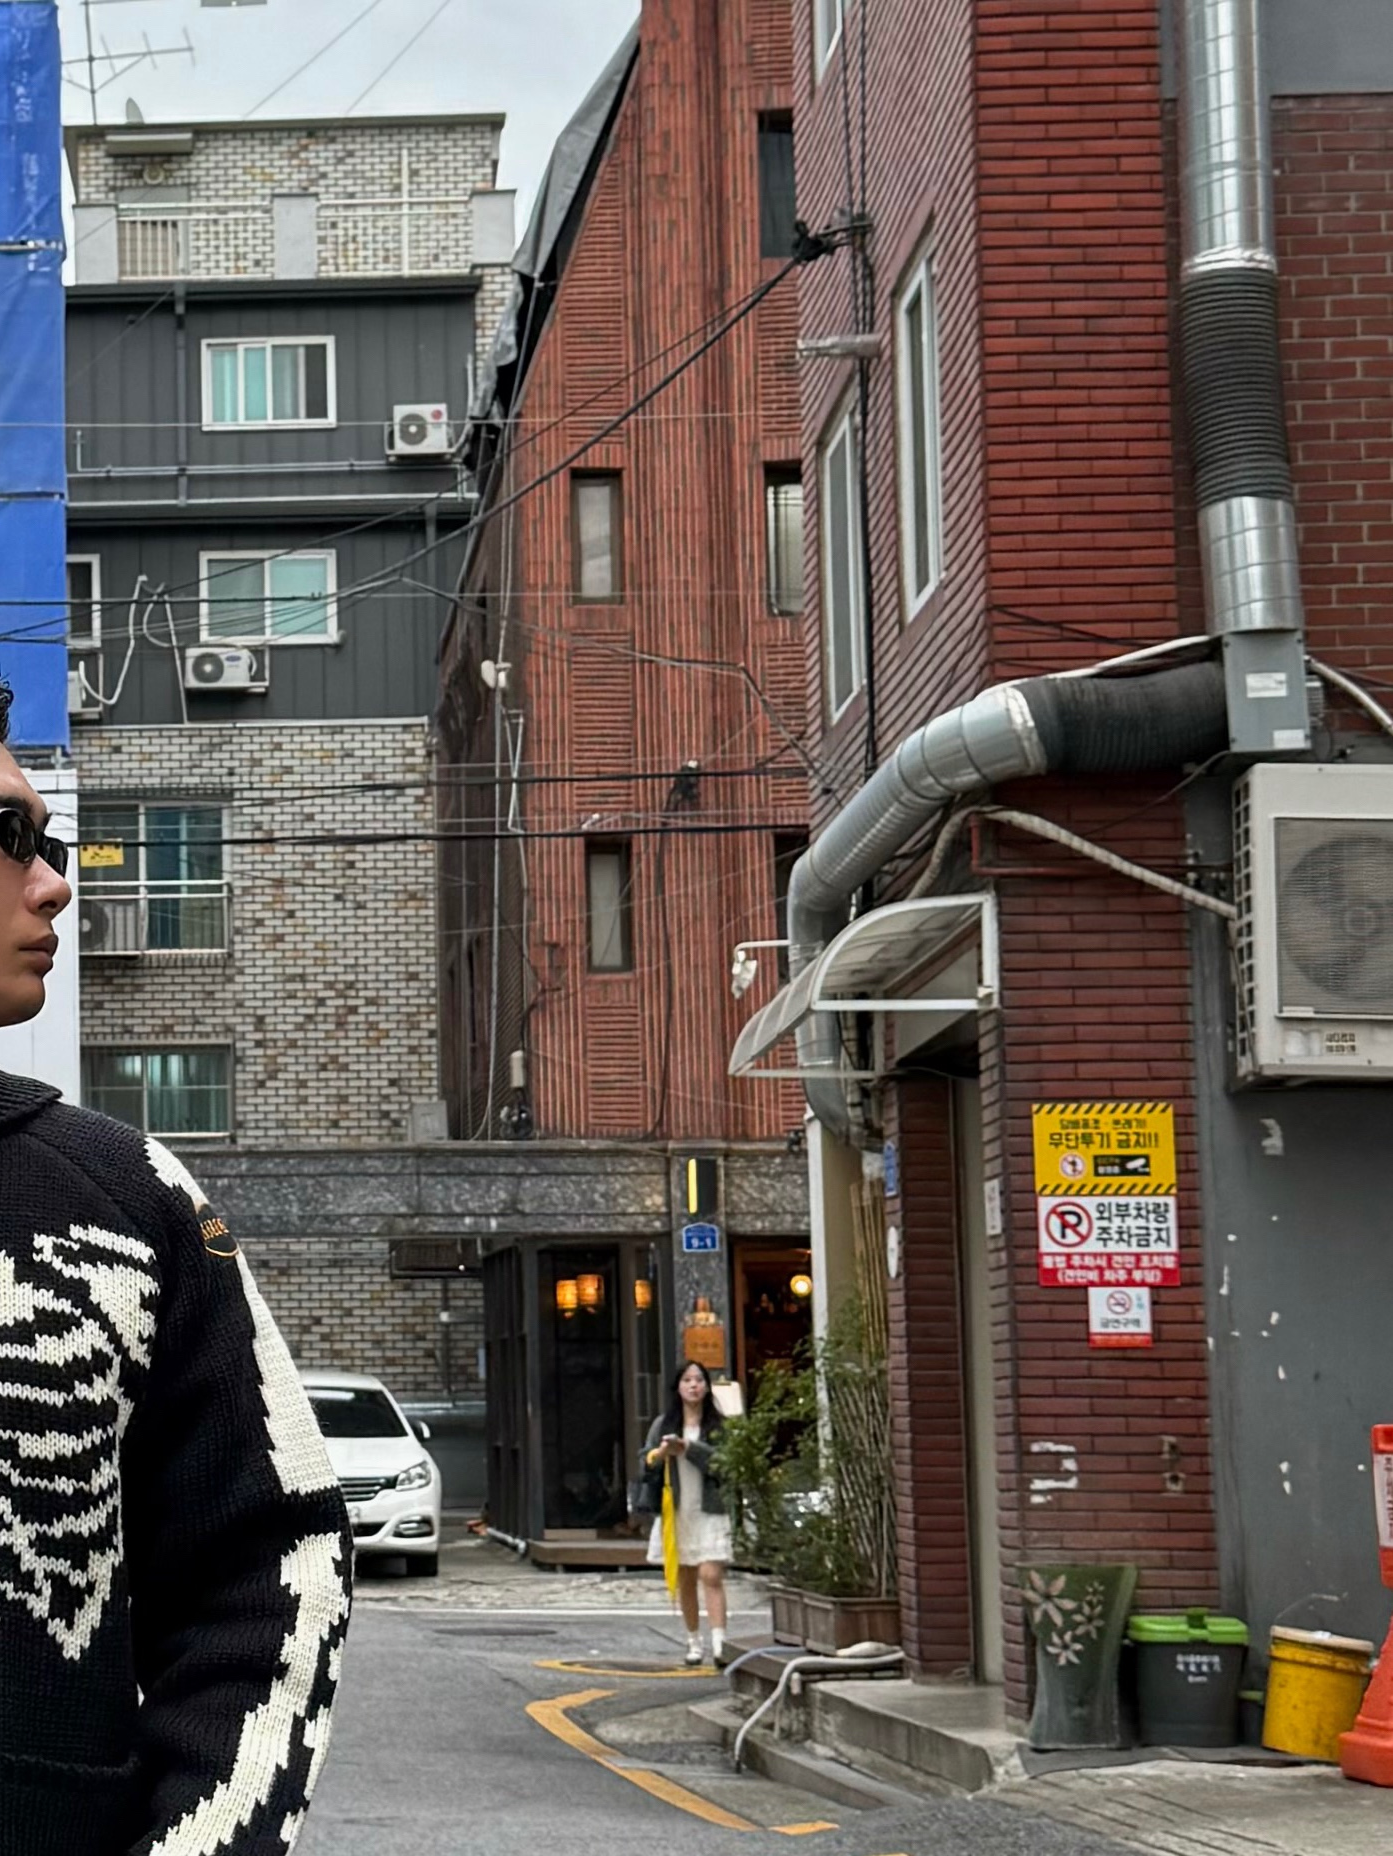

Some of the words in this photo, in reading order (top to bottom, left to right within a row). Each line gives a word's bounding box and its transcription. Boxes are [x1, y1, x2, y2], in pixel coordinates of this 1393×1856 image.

[1049, 1132, 1111, 1149] 무단투기
[1117, 1132, 1159, 1149] 금지!!
[1095, 1202, 1170, 1224] 외부차량
[1096, 1226, 1171, 1248] 주차금지
